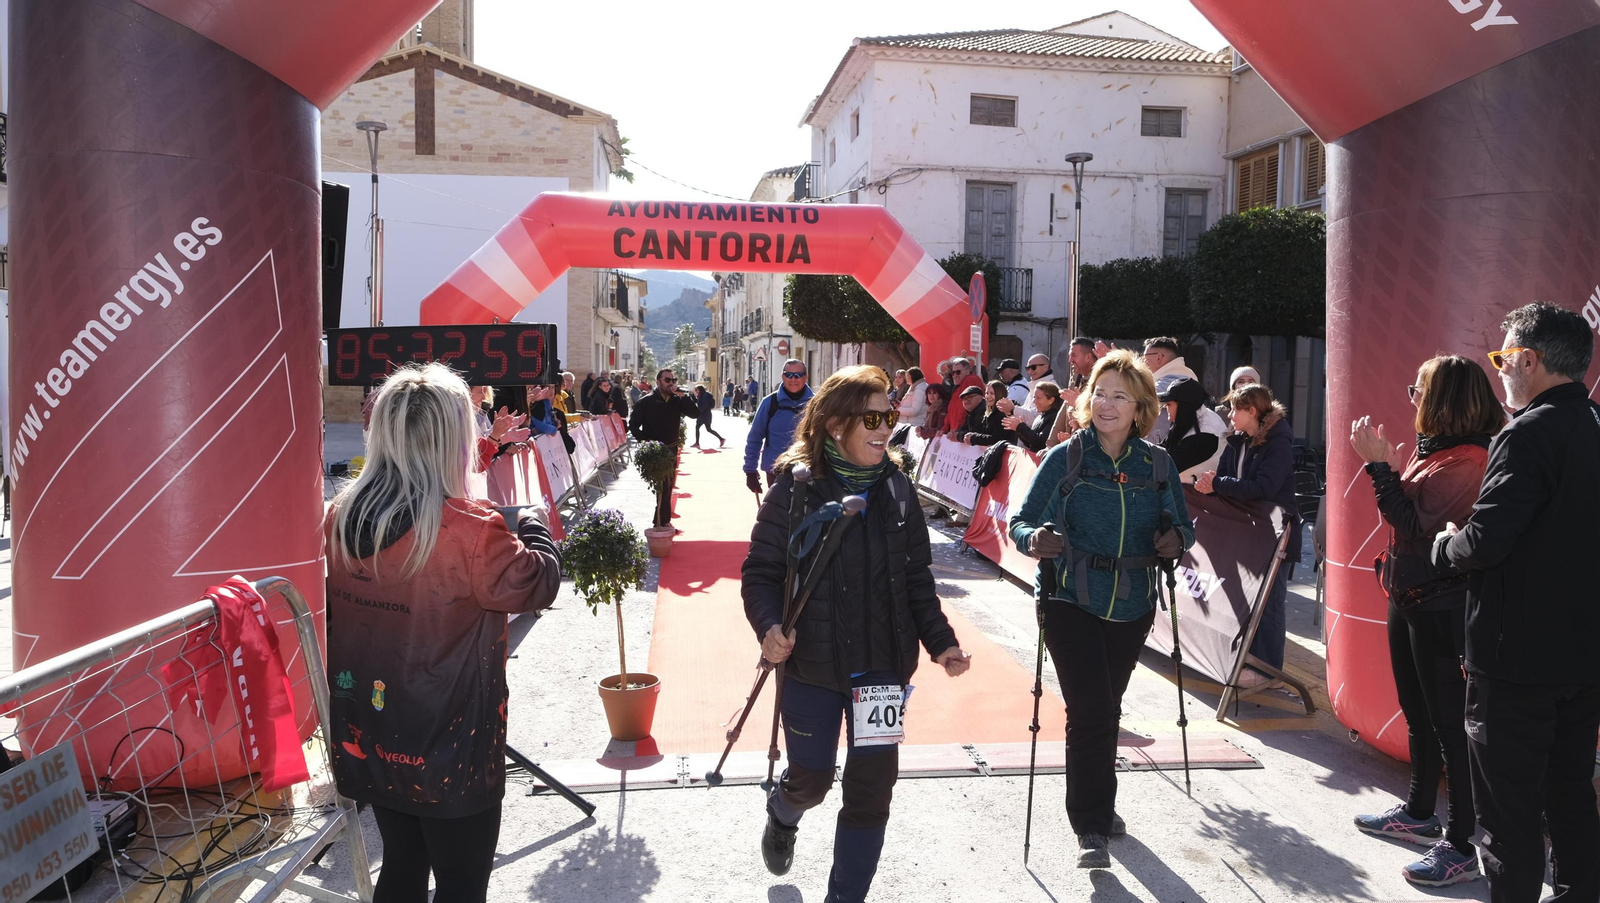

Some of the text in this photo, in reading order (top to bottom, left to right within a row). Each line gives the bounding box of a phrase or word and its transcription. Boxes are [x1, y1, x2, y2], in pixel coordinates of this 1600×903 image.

[607, 200, 819, 224] AYUNTAMIENTO
[613, 227, 811, 264] CANTORIA
[9, 216, 223, 491] www.teamergy.es
[342, 591, 351, 602] DE
[354, 596, 411, 615] ALMANZORA
[41, 752, 69, 787] DE
[384, 752, 425, 766] VEOLIA
[2, 832, 89, 902] 950 453 550
